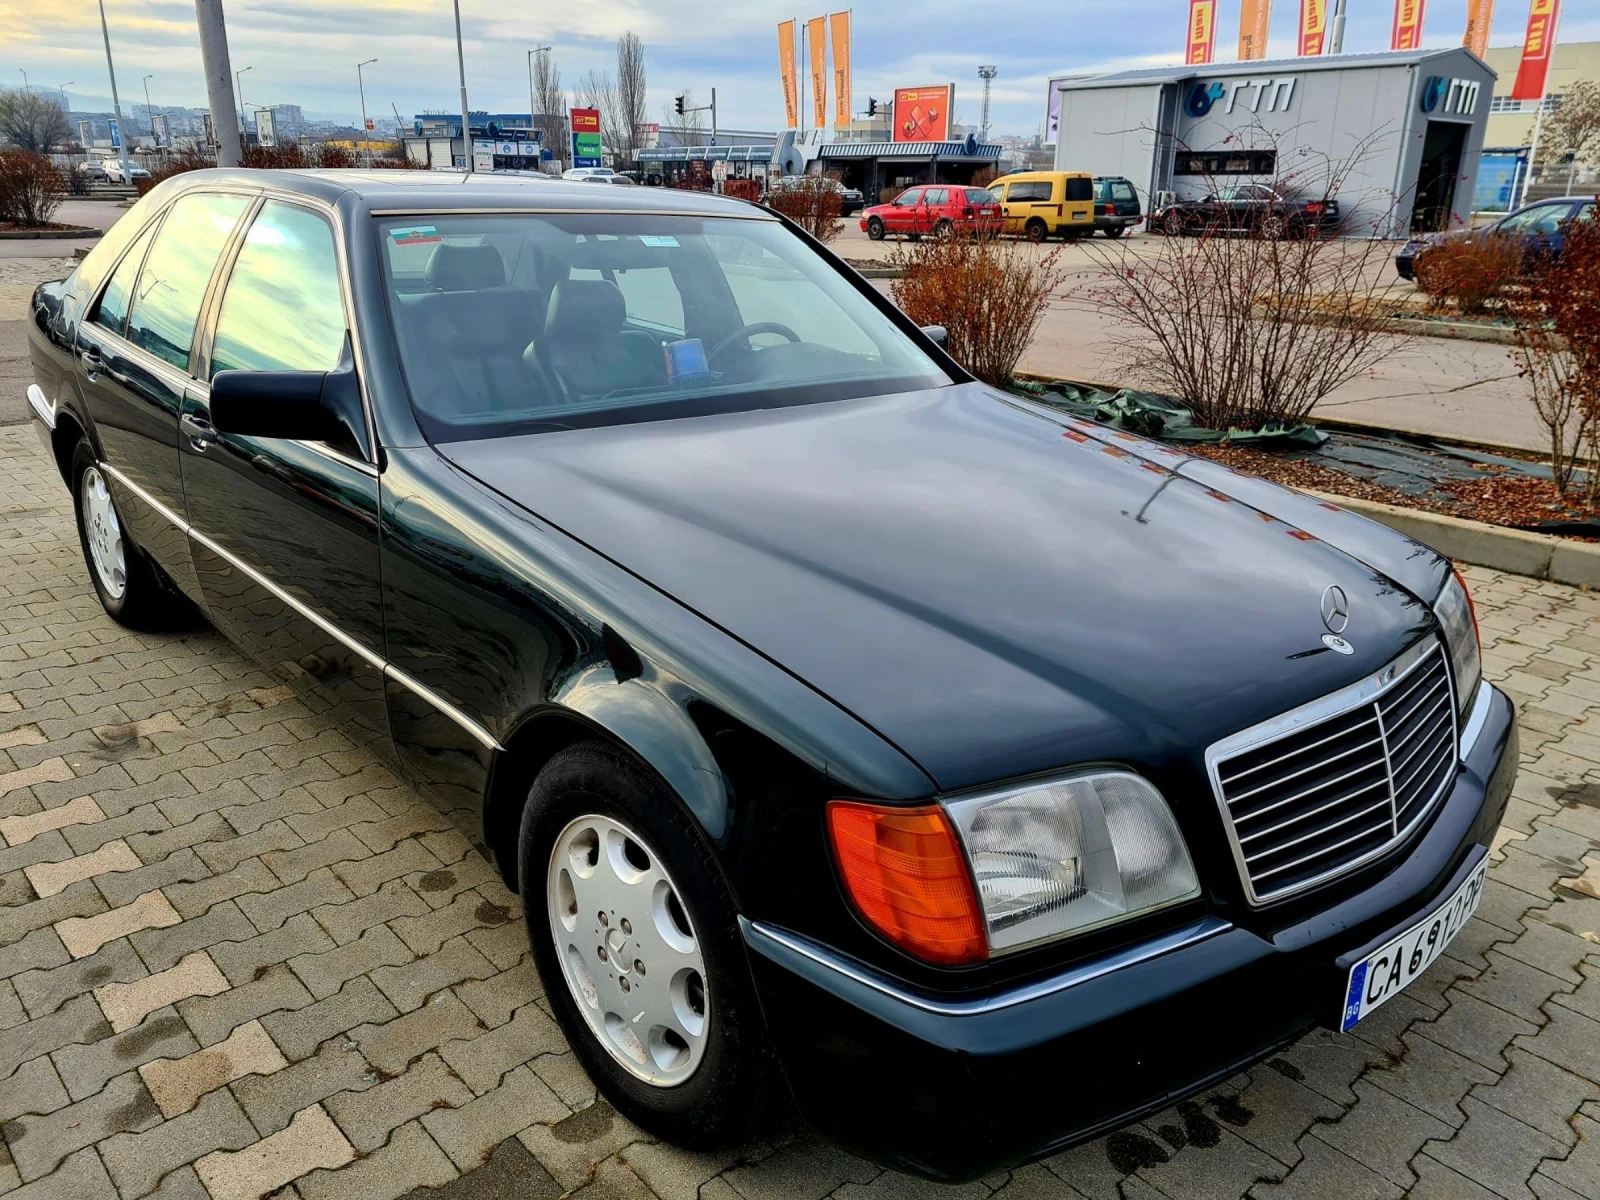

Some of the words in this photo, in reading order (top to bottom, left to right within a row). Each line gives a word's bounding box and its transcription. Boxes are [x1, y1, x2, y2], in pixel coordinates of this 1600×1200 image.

[1224, 78, 1297, 114] ГТП
[1444, 78, 1480, 115] ГТП
[1367, 946, 1403, 1005] CA
[1408, 896, 1463, 976] 6912
[1459, 867, 1485, 925] PP
[1345, 1001, 1359, 1020] BG
